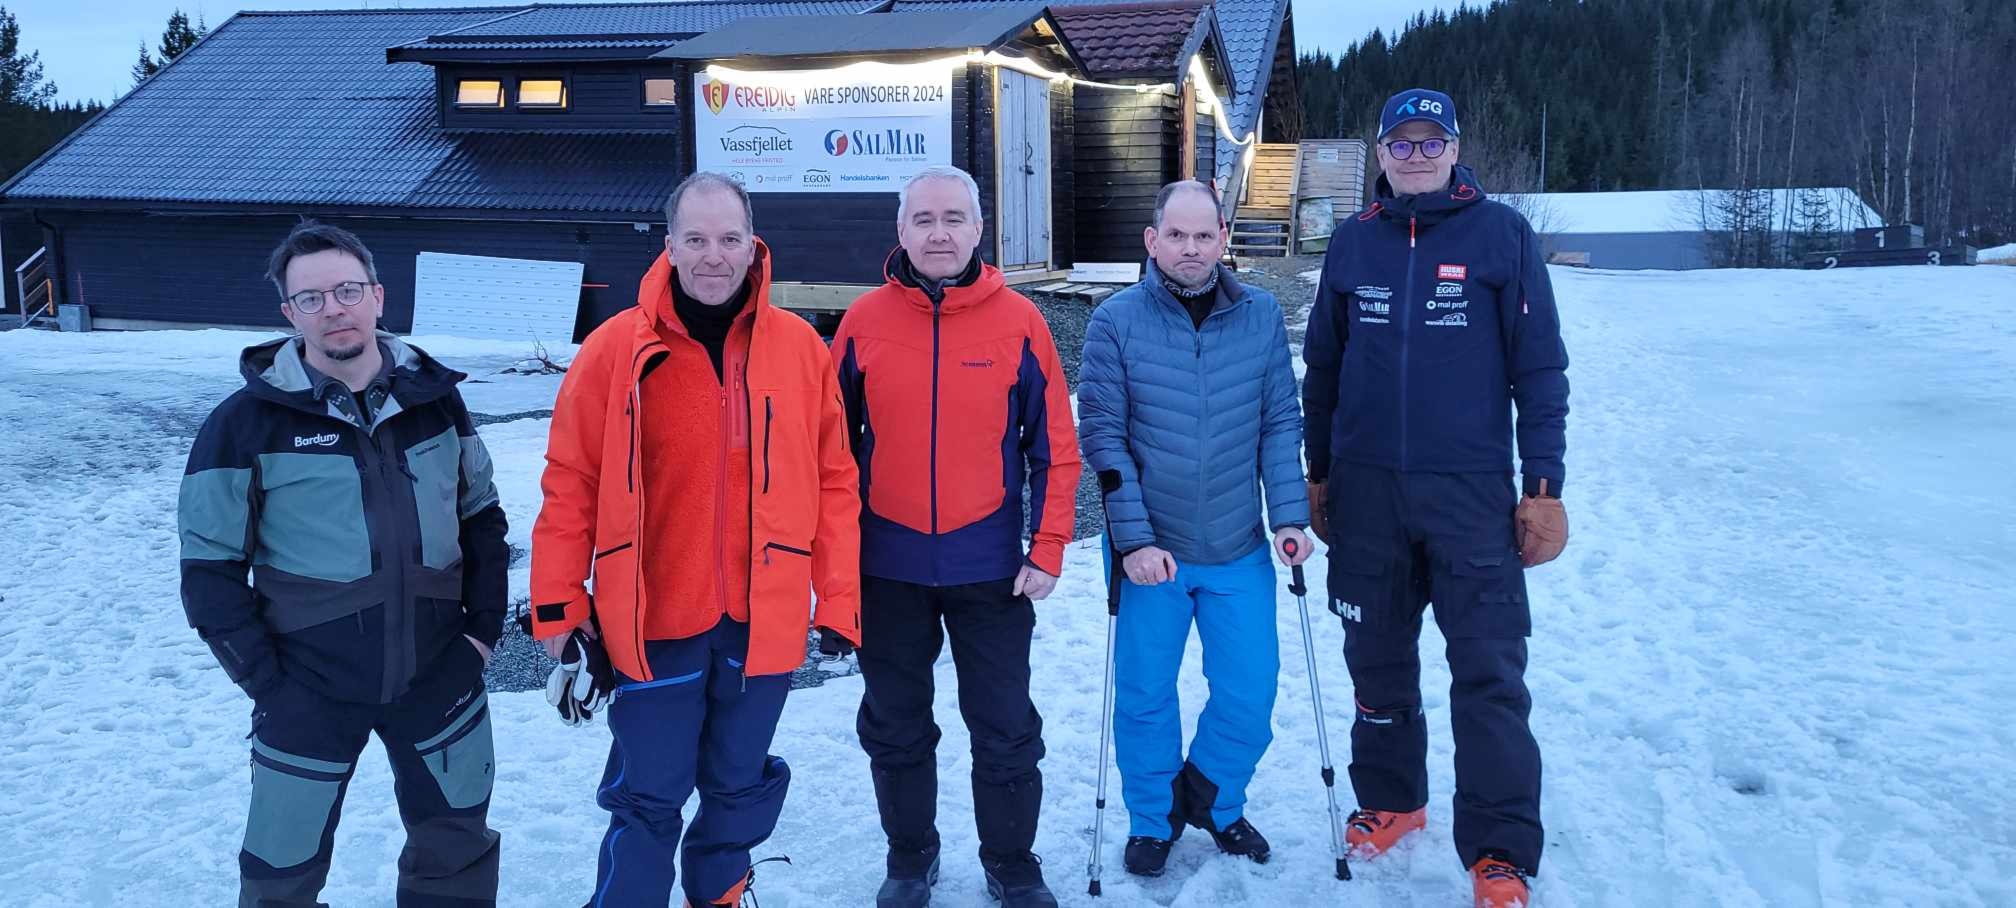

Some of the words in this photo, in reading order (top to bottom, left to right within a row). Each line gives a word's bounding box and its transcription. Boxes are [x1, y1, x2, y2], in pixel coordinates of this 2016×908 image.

[804, 87, 834, 104] VARE
[837, 85, 911, 104] SPONSORER
[913, 84, 944, 102] 2024
[1419, 99, 1443, 115] 5G
[720, 136, 793, 156] Vassfjellet
[803, 174, 831, 183] EGON
[840, 174, 890, 182] Handelsbanken
[1875, 230, 1886, 248] 1
[1824, 256, 1839, 269] 2
[1927, 250, 1942, 266] 3
[1436, 285, 1463, 294] EGON
[1437, 301, 1451, 309] mal
[294, 432, 340, 447] Bardum
